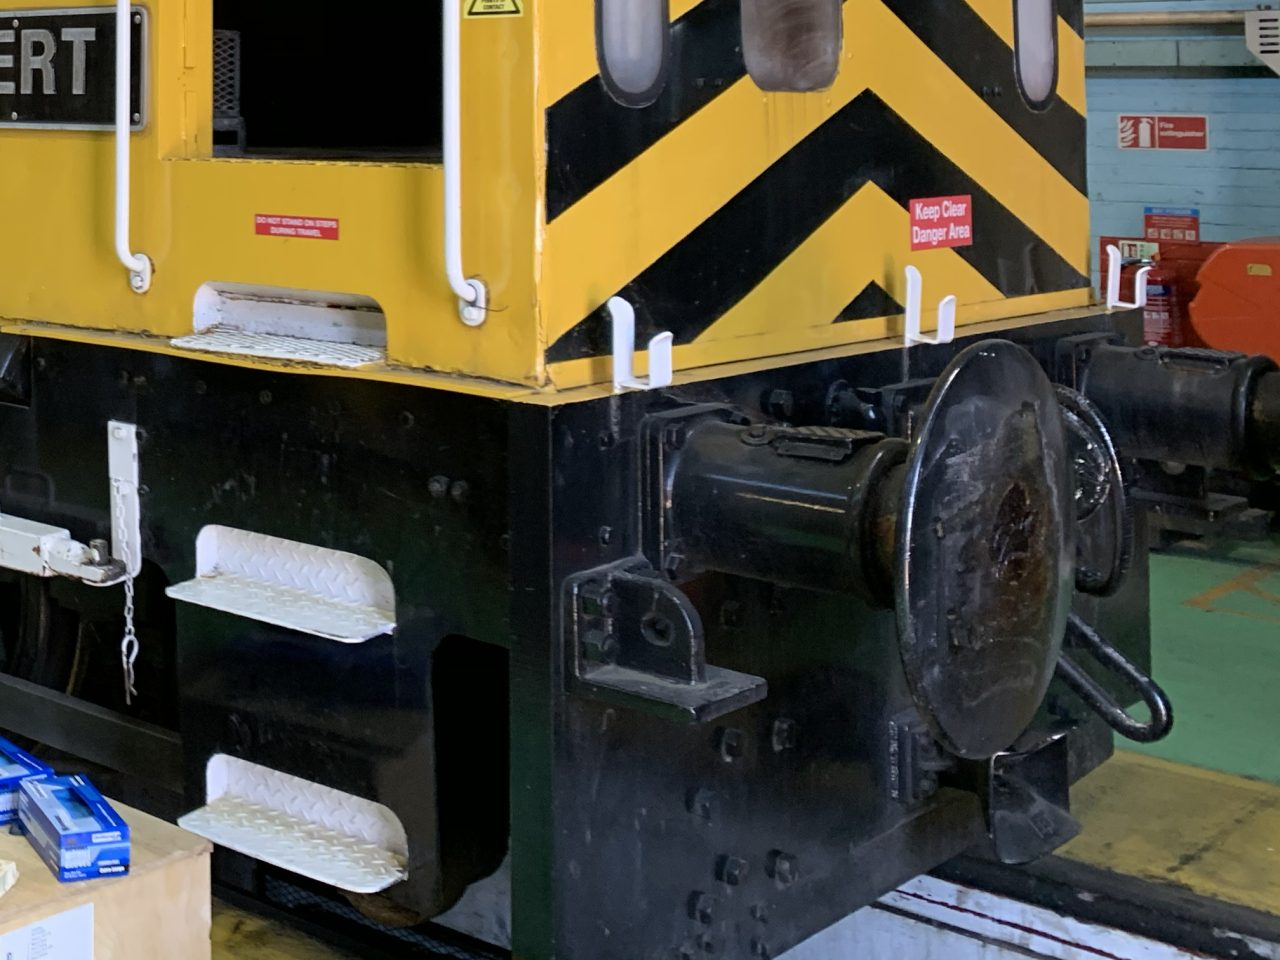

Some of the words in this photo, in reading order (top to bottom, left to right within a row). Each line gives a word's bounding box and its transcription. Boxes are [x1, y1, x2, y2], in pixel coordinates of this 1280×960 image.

[915, 202, 940, 223] Keep
[942, 199, 967, 218] Clear
[256, 216, 266, 224] DO
[281, 218, 303, 226] STAND
[303, 219, 315, 227] ON
[315, 220, 337, 228] STEPS
[270, 226, 296, 235] DURING
[297, 228, 322, 237] TRAVEL
[912, 226, 948, 246] Danger
[949, 222, 970, 239] Area
